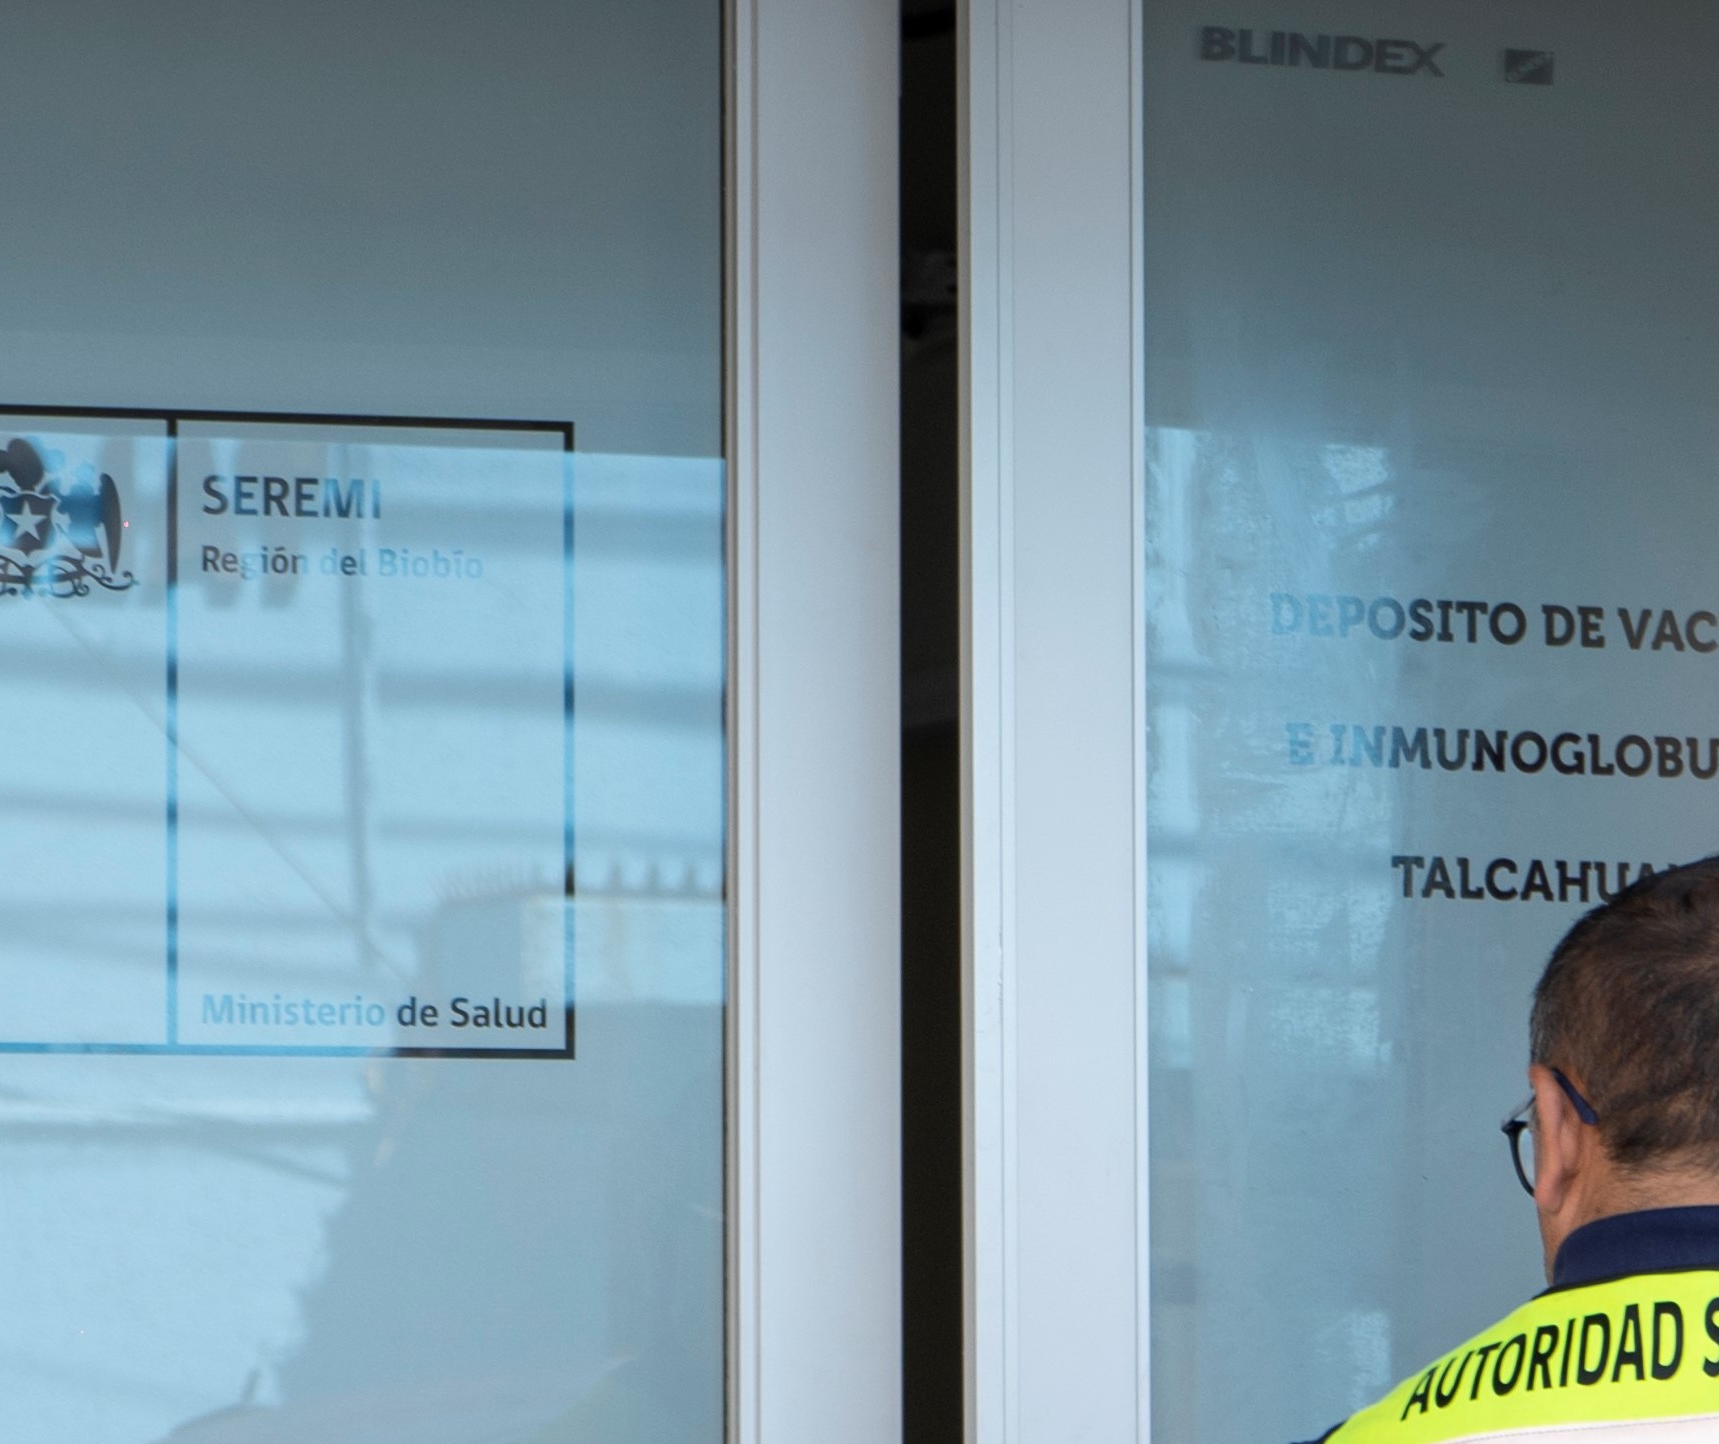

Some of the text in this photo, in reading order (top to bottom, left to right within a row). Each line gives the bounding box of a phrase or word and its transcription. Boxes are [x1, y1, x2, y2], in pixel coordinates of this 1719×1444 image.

[1199, 25, 1446, 77] BLINDEX
[202, 474, 381, 519] SEREMI
[319, 548, 368, 577] del
[1269, 593, 1527, 645] DEPOSITO
[1541, 604, 1606, 649] DE
[1285, 722, 1314, 766] E
[1391, 855, 1678, 903] TALCAHU
[201, 994, 548, 1029] Ministerio de Salud
[1400, 1299, 1684, 1422] AUTORIDAD
